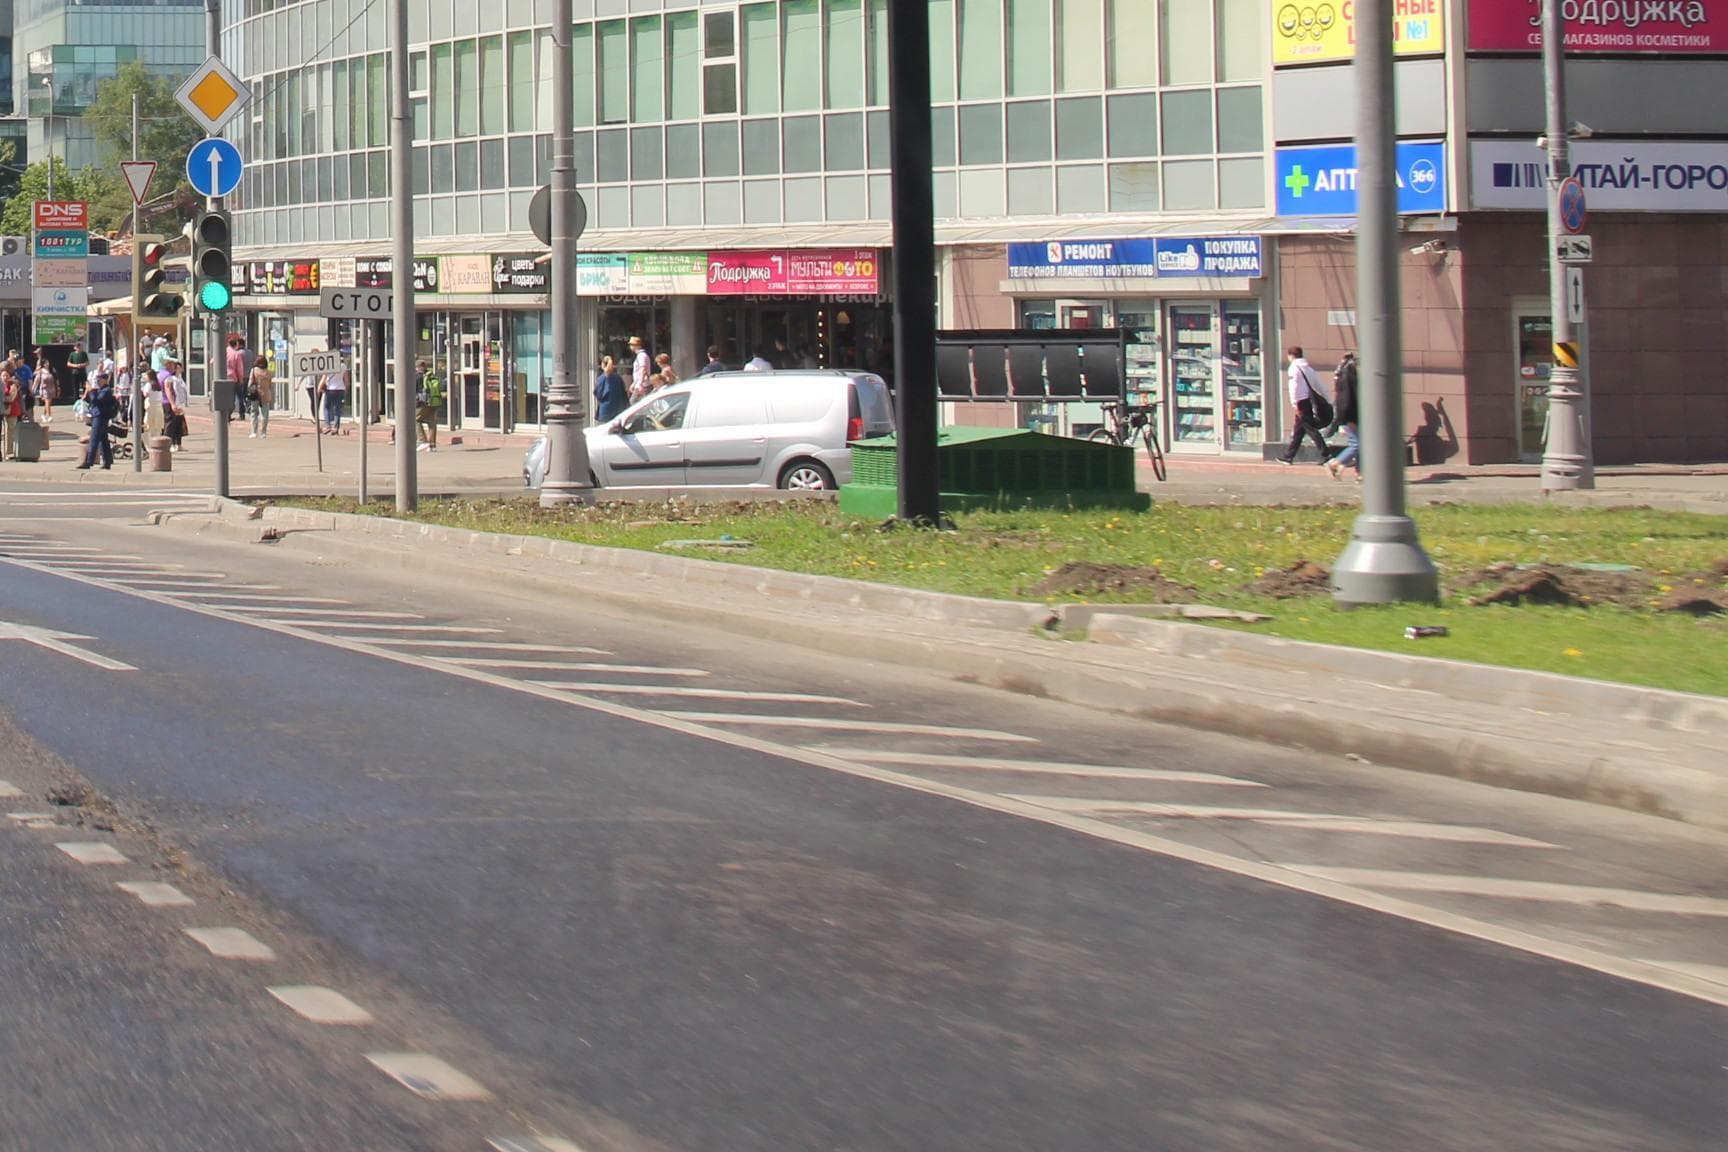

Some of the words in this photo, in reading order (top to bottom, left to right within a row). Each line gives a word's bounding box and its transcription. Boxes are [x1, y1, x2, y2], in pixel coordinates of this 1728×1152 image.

[1636, 34, 1710, 47] КОСМЕТИКИ
[39, 203, 83, 217] DNS
[40, 237, 83, 247] 1001ТУР
[1204, 241, 1257, 255] ПОКУПКА
[1064, 244, 1113, 261] РЕМОНТ
[1009, 265, 1056, 278] ТЕЛЕФОНОВ
[1057, 265, 1104, 277] ПЛАНШЕТОВ
[1106, 264, 1154, 276] НОУТБУКОВ
[1203, 256, 1259, 273] ПРОДАЖА
[709, 261, 771, 284] Подружка
[299, 355, 335, 373] СТОП
